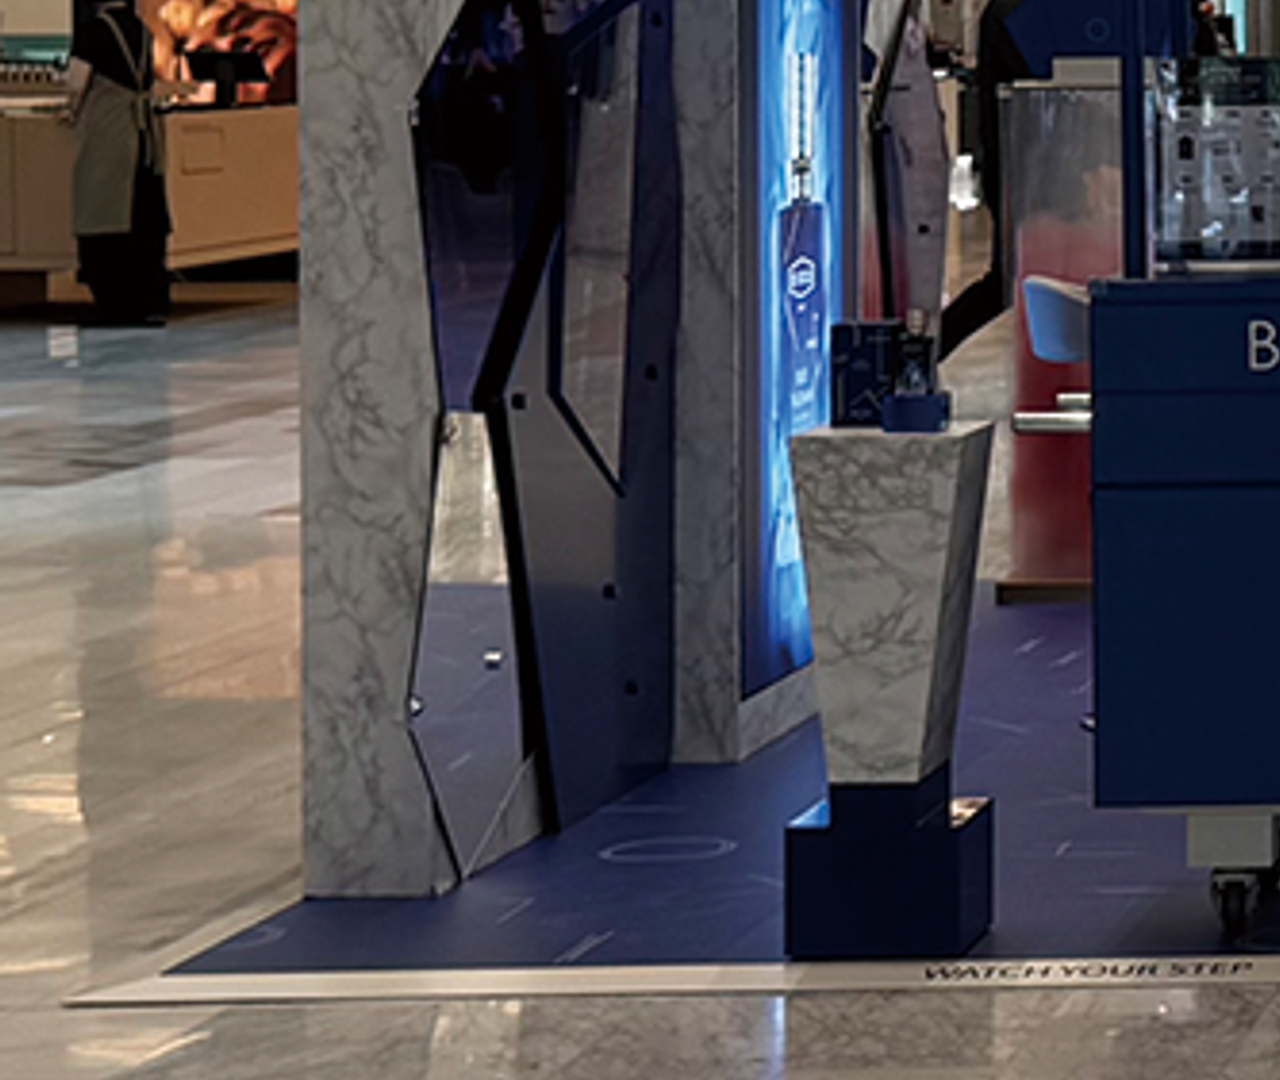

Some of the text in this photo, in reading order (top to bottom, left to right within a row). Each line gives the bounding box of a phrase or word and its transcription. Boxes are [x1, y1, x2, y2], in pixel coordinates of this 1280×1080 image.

[924, 960, 1254, 981] WATCH YOUR STEP
